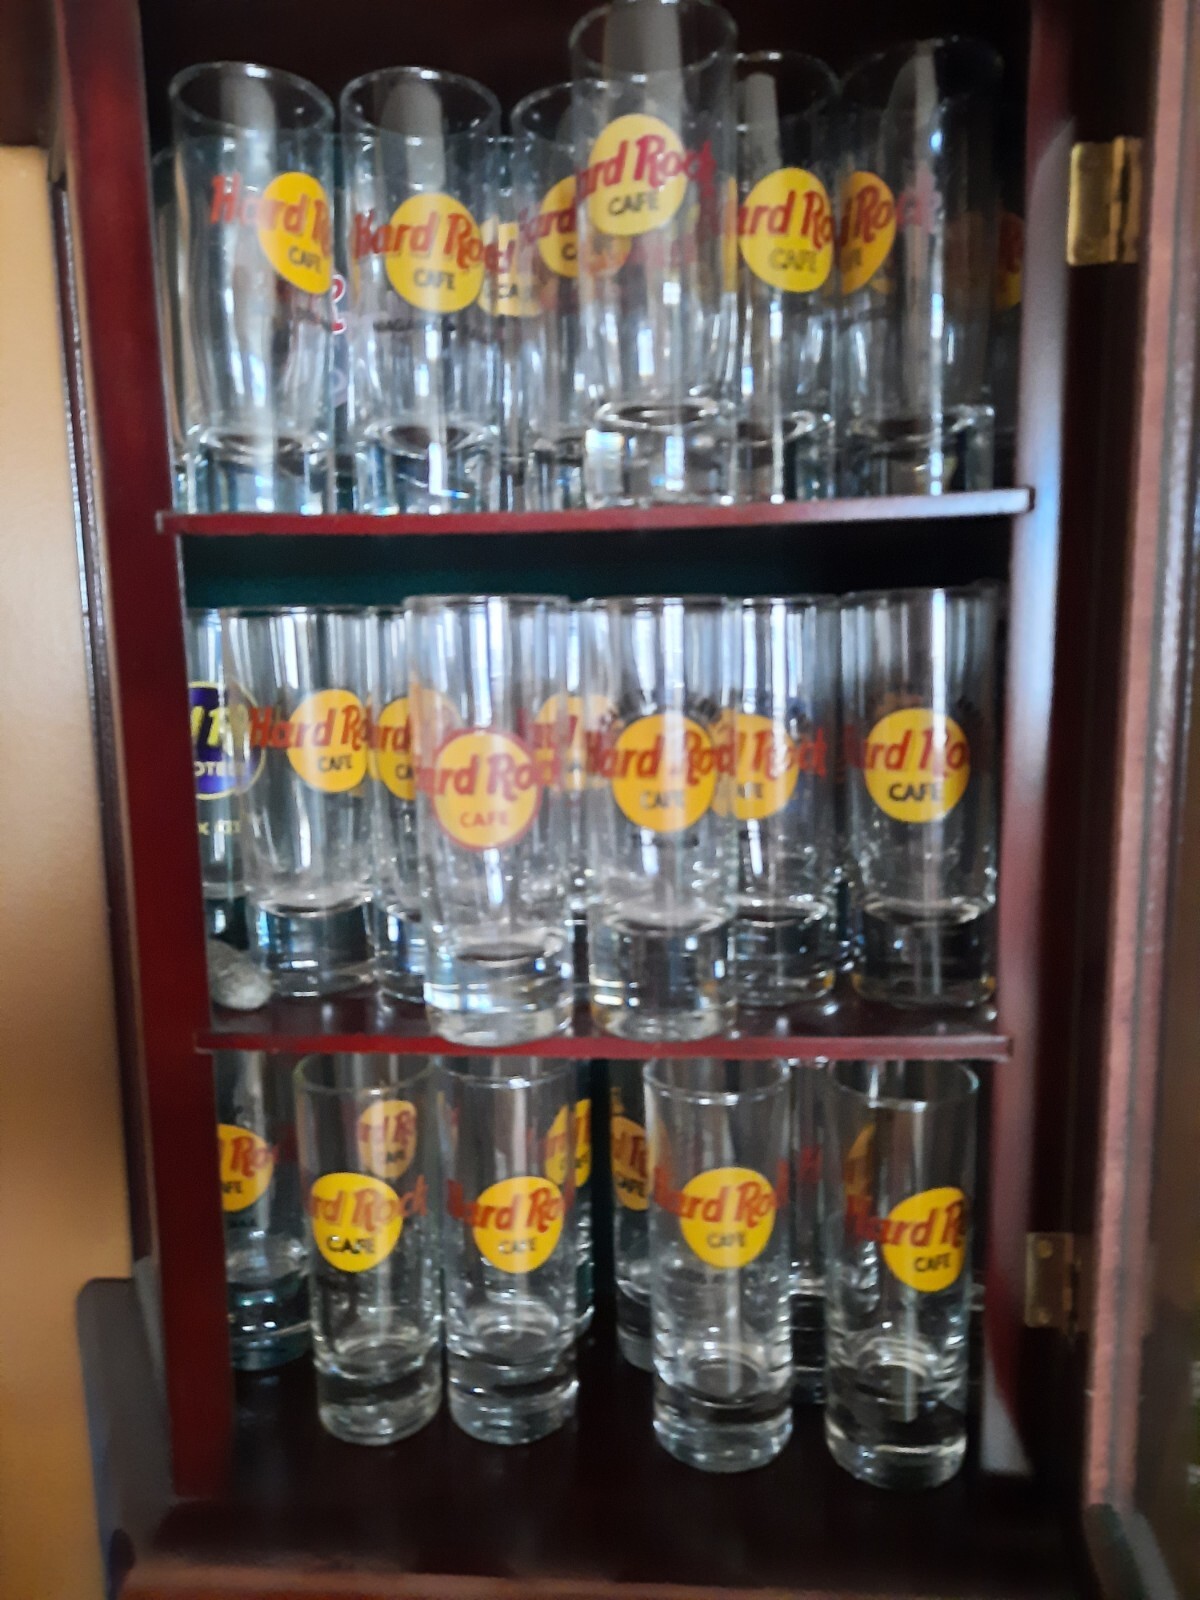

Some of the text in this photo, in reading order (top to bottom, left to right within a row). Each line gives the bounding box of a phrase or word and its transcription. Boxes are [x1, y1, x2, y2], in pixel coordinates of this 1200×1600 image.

[608, 192, 659, 216] CAFE
[737, 189, 796, 236] ard
[353, 208, 438, 259] Hard
[250, 704, 336, 748] Hard
[317, 753, 352, 772] CAFE
[416, 753, 478, 796] ard
[459, 811, 509, 829] CAFE
[914, 1252, 950, 1272] CAFE
